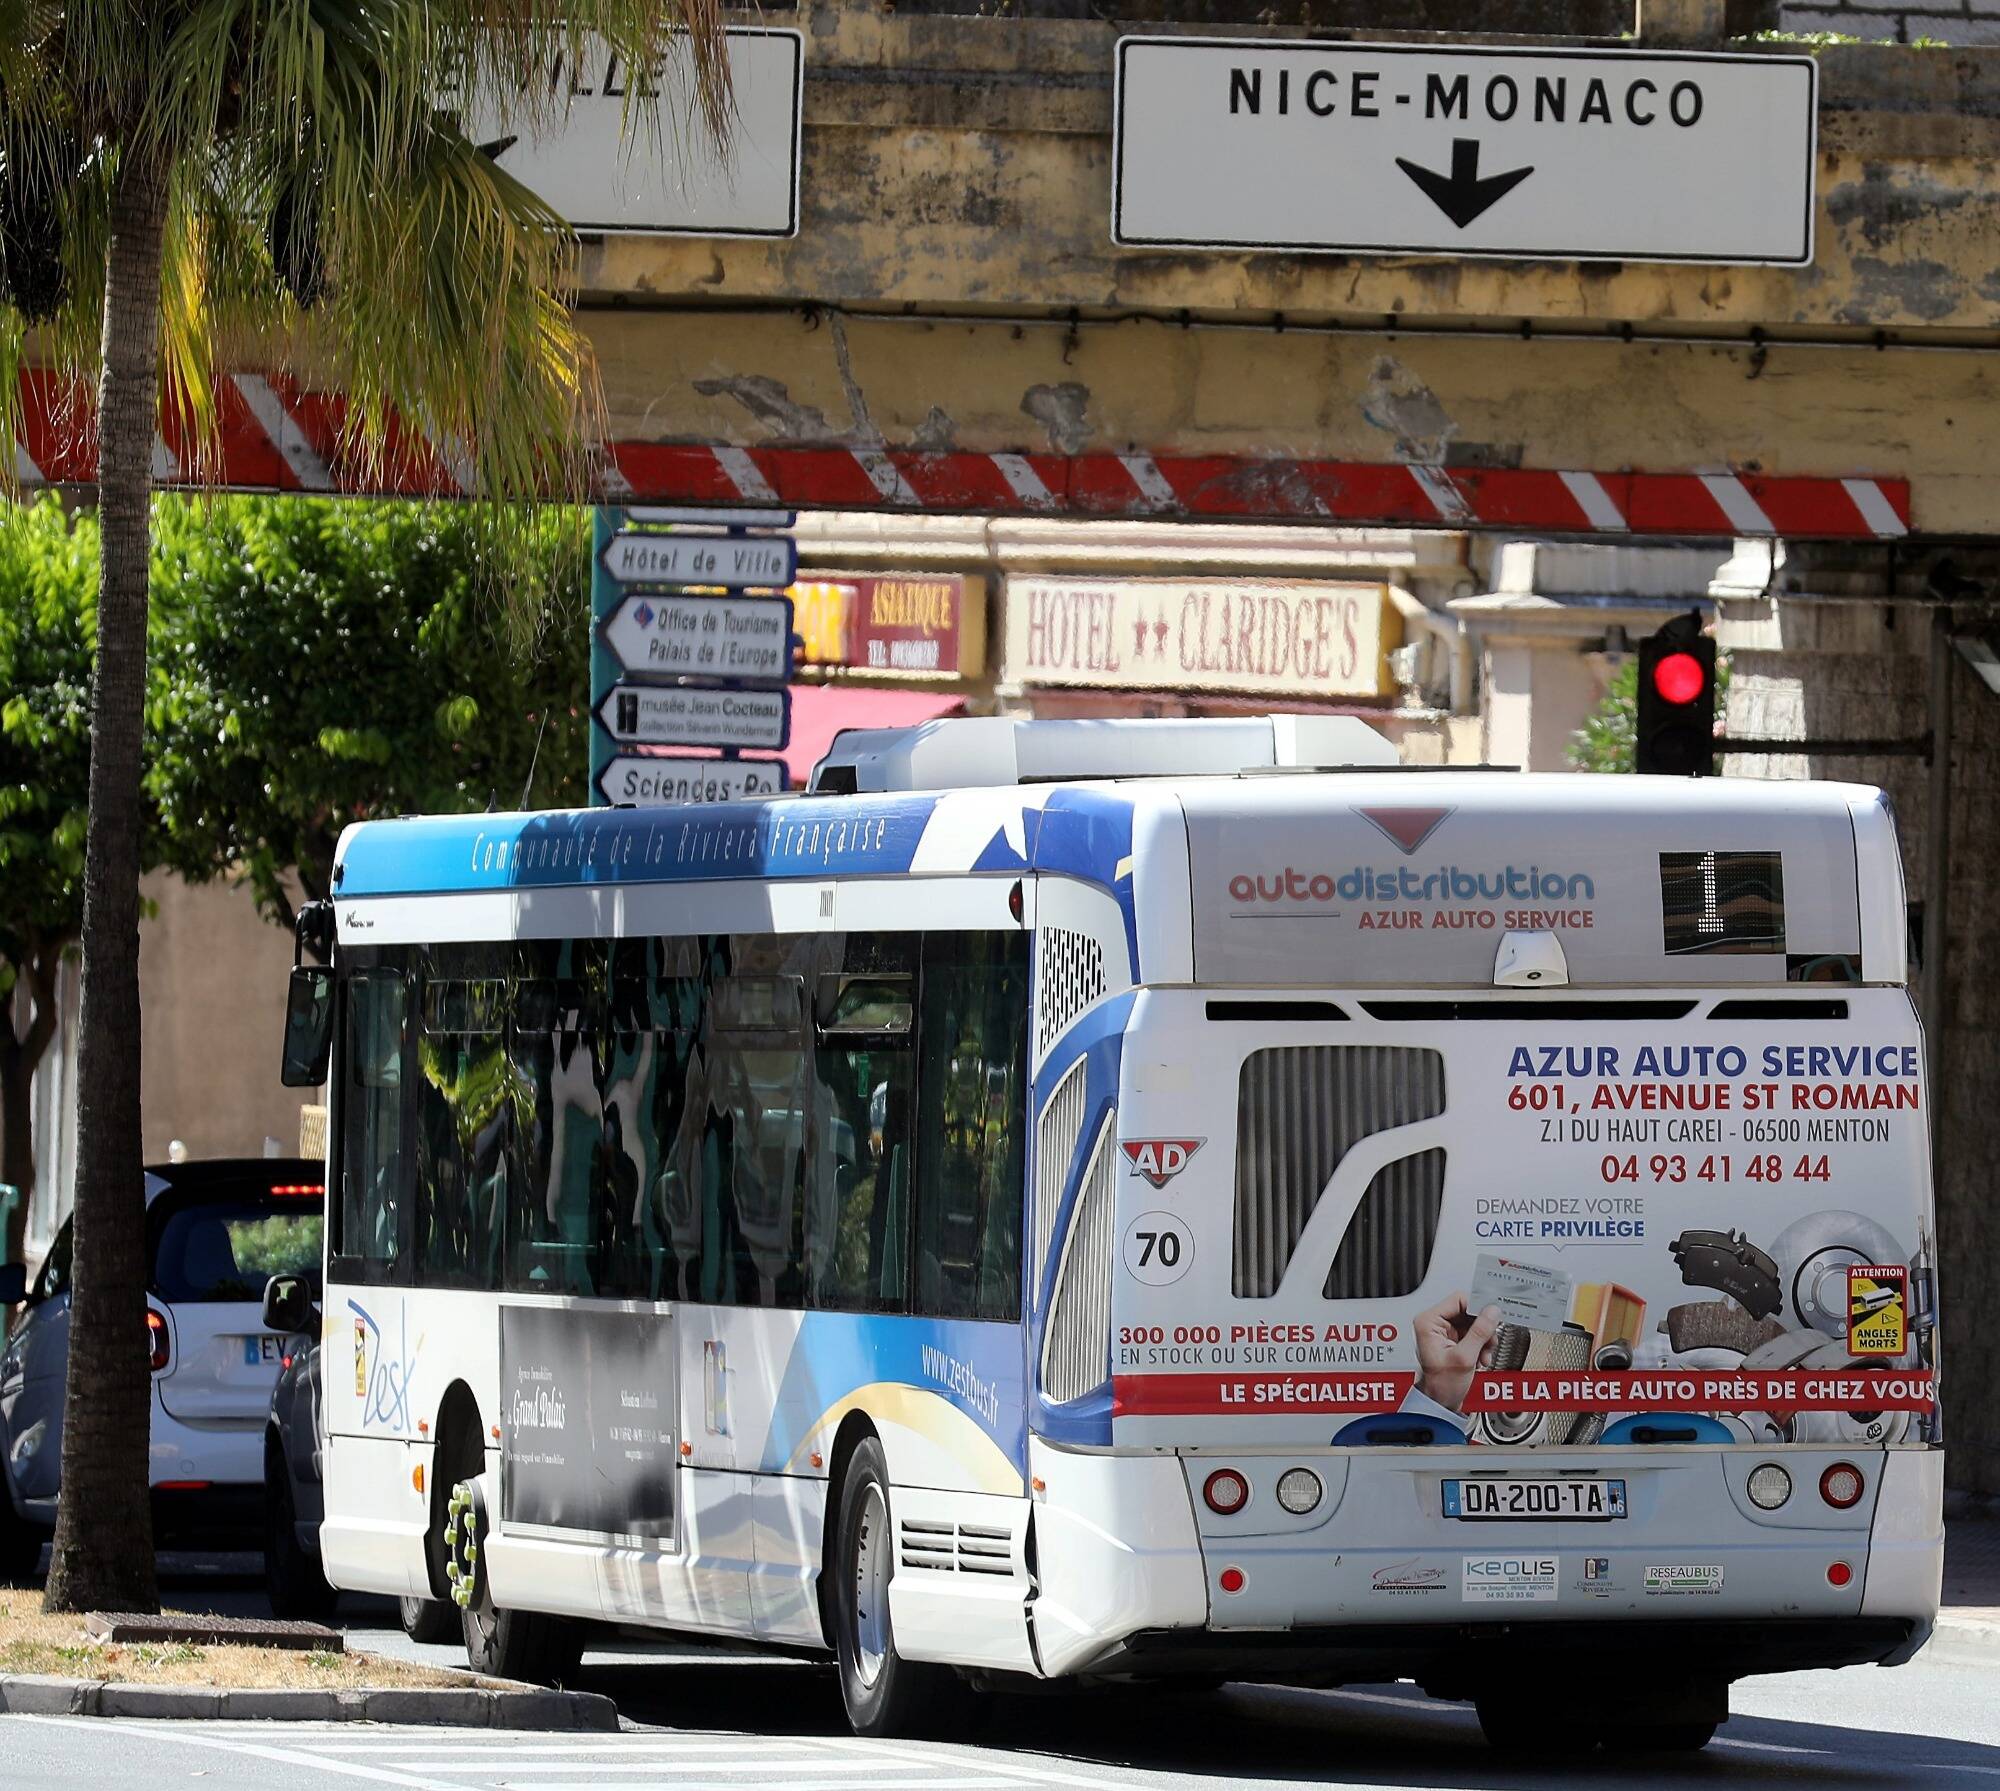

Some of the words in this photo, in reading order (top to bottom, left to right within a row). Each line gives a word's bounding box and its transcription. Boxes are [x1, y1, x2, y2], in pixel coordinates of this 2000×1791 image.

[1229, 68, 1705, 128] NICE-MONACO
[621, 547, 678, 570] Hôtel
[693, 549, 716, 571] de
[734, 550, 782, 573] Ville
[657, 607, 697, 630] Office
[702, 609, 718, 632] de
[723, 609, 779, 634] Tourisme
[1026, 590, 1120, 673] HOTEL
[1178, 591, 1359, 679] CLARIDGE'S
[648, 639, 691, 663] Palais
[700, 640, 714, 663] de
[720, 640, 778, 670] l'Europe
[640, 697, 686, 715] musée
[690, 698, 720, 716] Jean
[723, 697, 778, 717] Cocteau
[472, 824, 598, 872] Communauté
[610, 823, 632, 864] de
[644, 823, 665, 864] la
[678, 820, 757, 864] Riviera
[771, 812, 886, 867] Française
[1229, 865, 1595, 902] autodistribution
[1697, 850, 1724, 933] 1
[1358, 910, 1423, 930] AZUR
[1432, 910, 1496, 930] AUTO
[1504, 909, 1593, 929] SERVICE
[1508, 1046, 1619, 1077] AZUR
[1633, 1046, 1747, 1077] AUTO
[1761, 1046, 1918, 1077] SERVICE
[1508, 1084, 1580, 1115] 601,
[1591, 1084, 1731, 1110] AVENUE
[1742, 1084, 1779, 1110] ST
[1792, 1084, 1919, 1110] ROMAN
[1541, 1119, 1563, 1142] Z.I
[1572, 1119, 1599, 1142] DU
[1608, 1119, 1660, 1142] HAUT
[1667, 1119, 1722, 1142] CAREI
[1743, 1119, 1800, 1142] 06500
[1808, 1119, 1889, 1142] MENTON
[1130, 1143, 1187, 1176] AD
[1601, 1155, 1639, 1183] 04
[1649, 1155, 1687, 1182] 93
[1697, 1155, 1731, 1182] 41
[1745, 1155, 1783, 1182] 48
[1793, 1155, 1831, 1182] 44
[1476, 1199, 1580, 1215] DEMANDEZ
[1589, 1198, 1643, 1214] VOTRE
[1476, 1221, 1534, 1237] CARTE
[1541, 1215, 1644, 1237] PRIVILÈGE
[1136, 1232, 1181, 1267] 70
[1851, 1268, 1903, 1277] ATTENTION
[1119, 1326, 1164, 1345] 300
[1173, 1326, 1221, 1344] 000
[1230, 1320, 1315, 1344] PIÈCES
[1324, 1324, 1398, 1343] AUTO
[1857, 1329, 1898, 1338] ANGLES
[1859, 1339, 1897, 1348] MORTS
[1120, 1348, 1141, 1364] EN
[1149, 1348, 1203, 1364] STOCK
[1211, 1348, 1234, 1364] OU
[1243, 1347, 1277, 1363] SUR
[921, 1344, 998, 1427] www.zestbus.fr
[1220, 1383, 1245, 1403] LE
[1253, 1378, 1396, 1402] SPÉCIALISTE
[1483, 1381, 1513, 1400] DE
[1522, 1381, 1551, 1400] LA
[1558, 1375, 1621, 1400] PIÈCE
[1628, 1381, 1696, 1400] AUTO
[1705, 1375, 1759, 1400] PRÈS
[1767, 1381, 1796, 1400] DE
[1804, 1381, 1863, 1400] CHEZ
[1875, 1381, 1935, 1400] VOUS
[513, 1385, 540, 1439] Grand
[539, 1386, 565, 1429] Palais
[1466, 1484, 1603, 1512] DA-200-TA
[1650, 1567, 1719, 1578] RESEAUBUS
